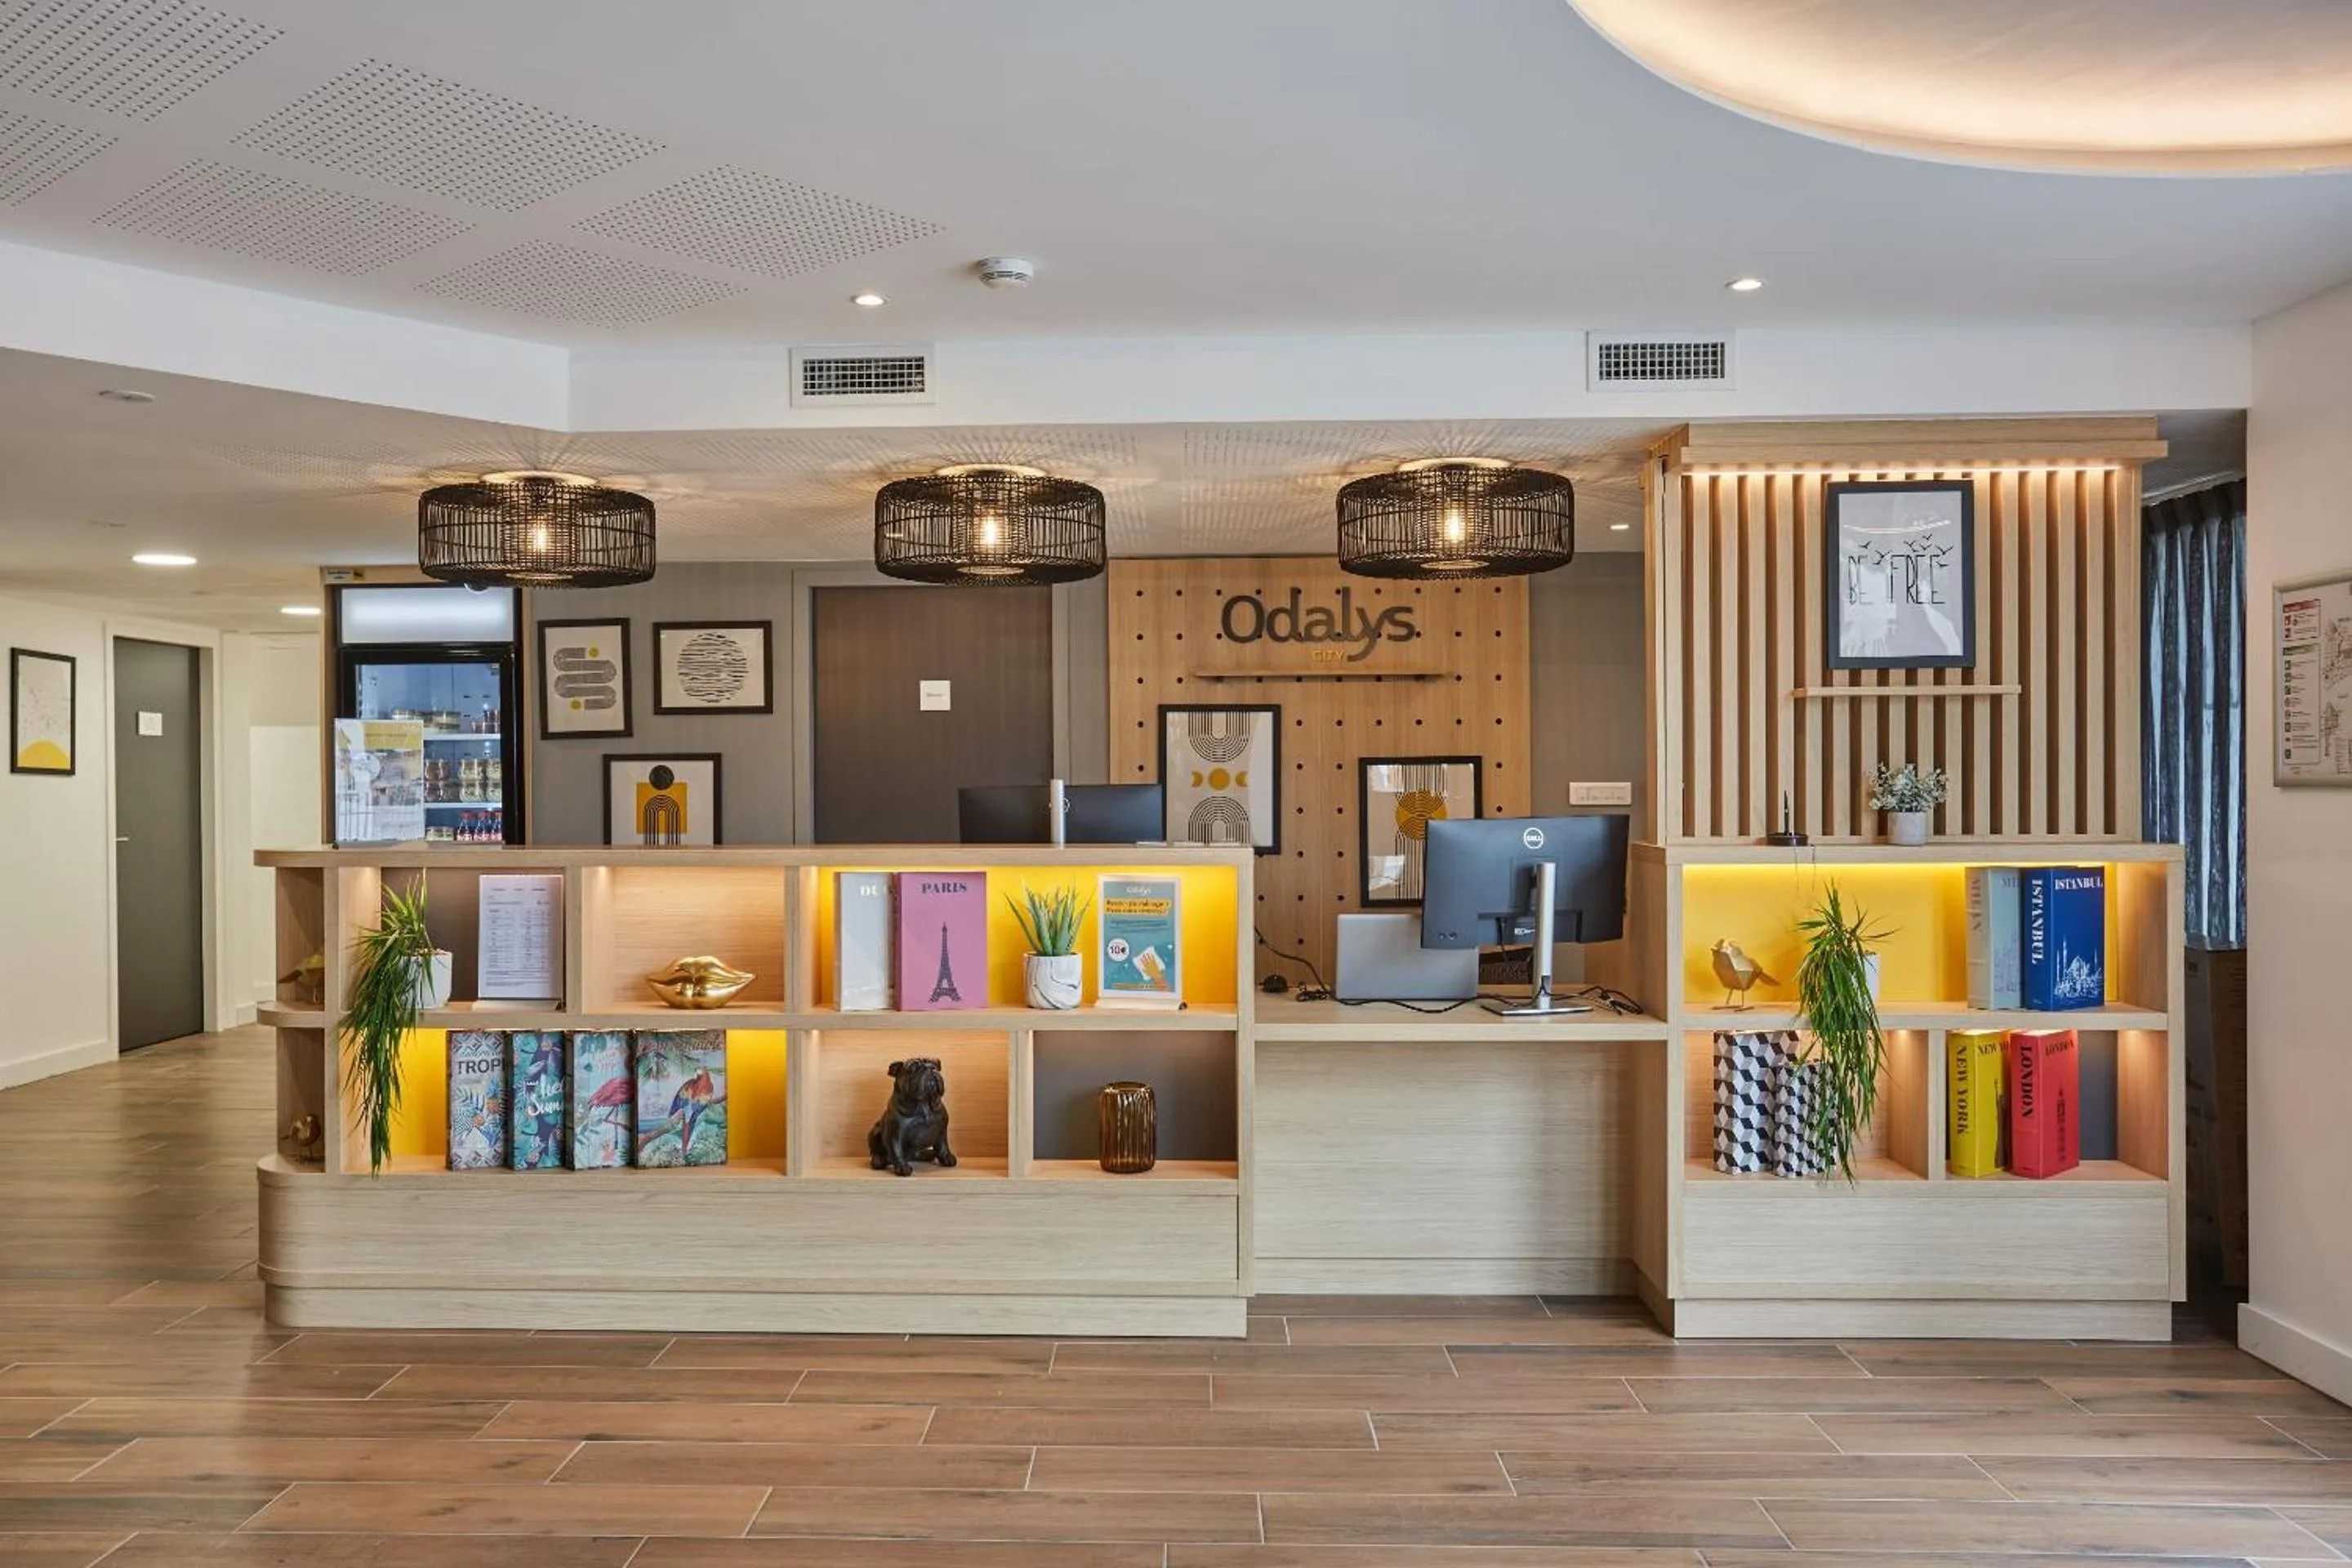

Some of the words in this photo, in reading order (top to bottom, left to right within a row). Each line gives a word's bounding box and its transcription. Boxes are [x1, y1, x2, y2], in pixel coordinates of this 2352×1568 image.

[1890, 554, 1945, 604] FREE
[1221, 586, 1416, 662] Odalys
[1311, 650, 1344, 662] CITY
[921, 882, 968, 894] PARIS
[2054, 875, 2103, 890] ISTANBUL
[1971, 878, 1983, 933] MILAN
[2031, 878, 2045, 965] ISTANBUL
[1957, 1042, 1967, 1083] NEW
[1978, 1042, 1998, 1055] NEW
[2045, 1039, 2074, 1057] LONDON
[2020, 1045, 2034, 1120] LONDON
[1958, 1089, 1969, 1136] YORK
